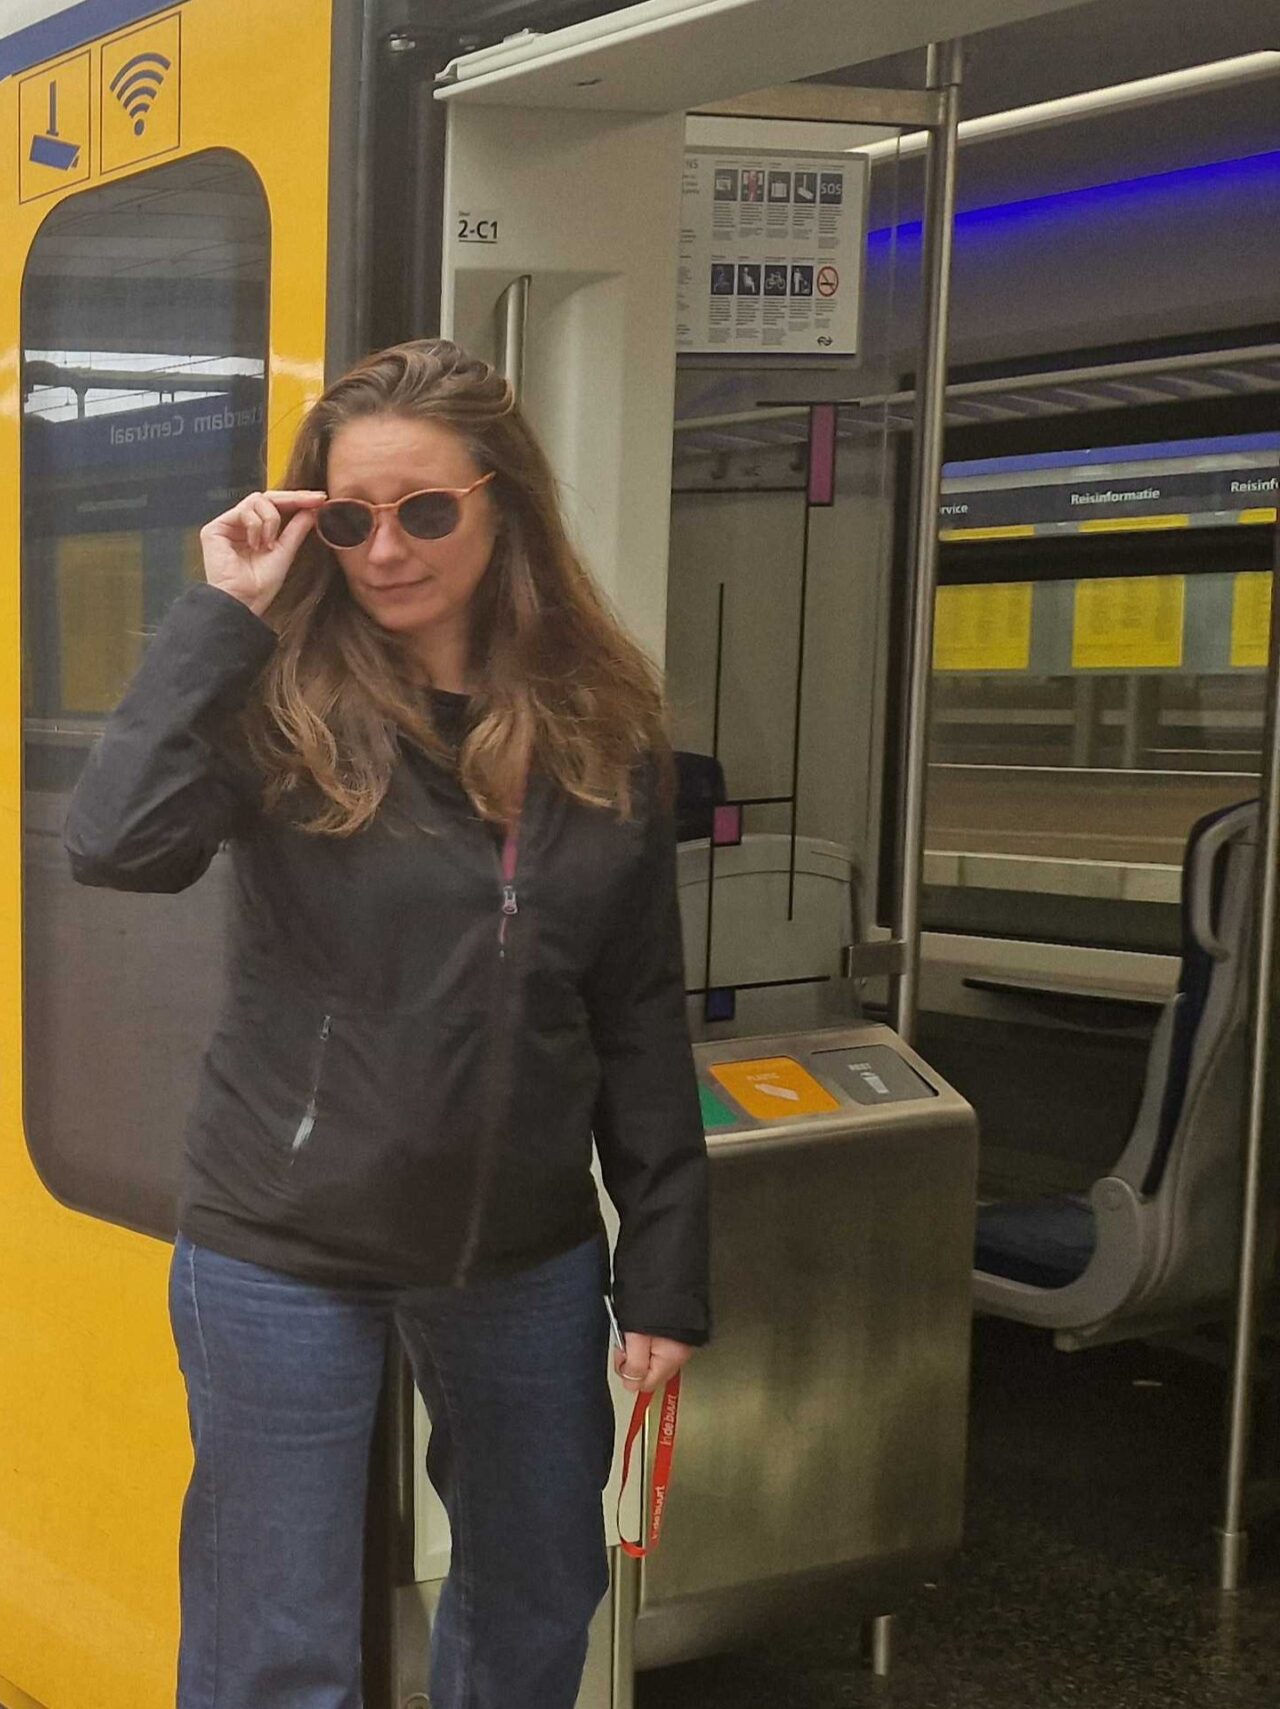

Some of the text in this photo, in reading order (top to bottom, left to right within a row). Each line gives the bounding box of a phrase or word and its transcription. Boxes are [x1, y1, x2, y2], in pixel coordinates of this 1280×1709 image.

[821, 182, 842, 195] SOS
[458, 219, 498, 240] 2-C1
[1071, 487, 1160, 505] Reisinformatie
